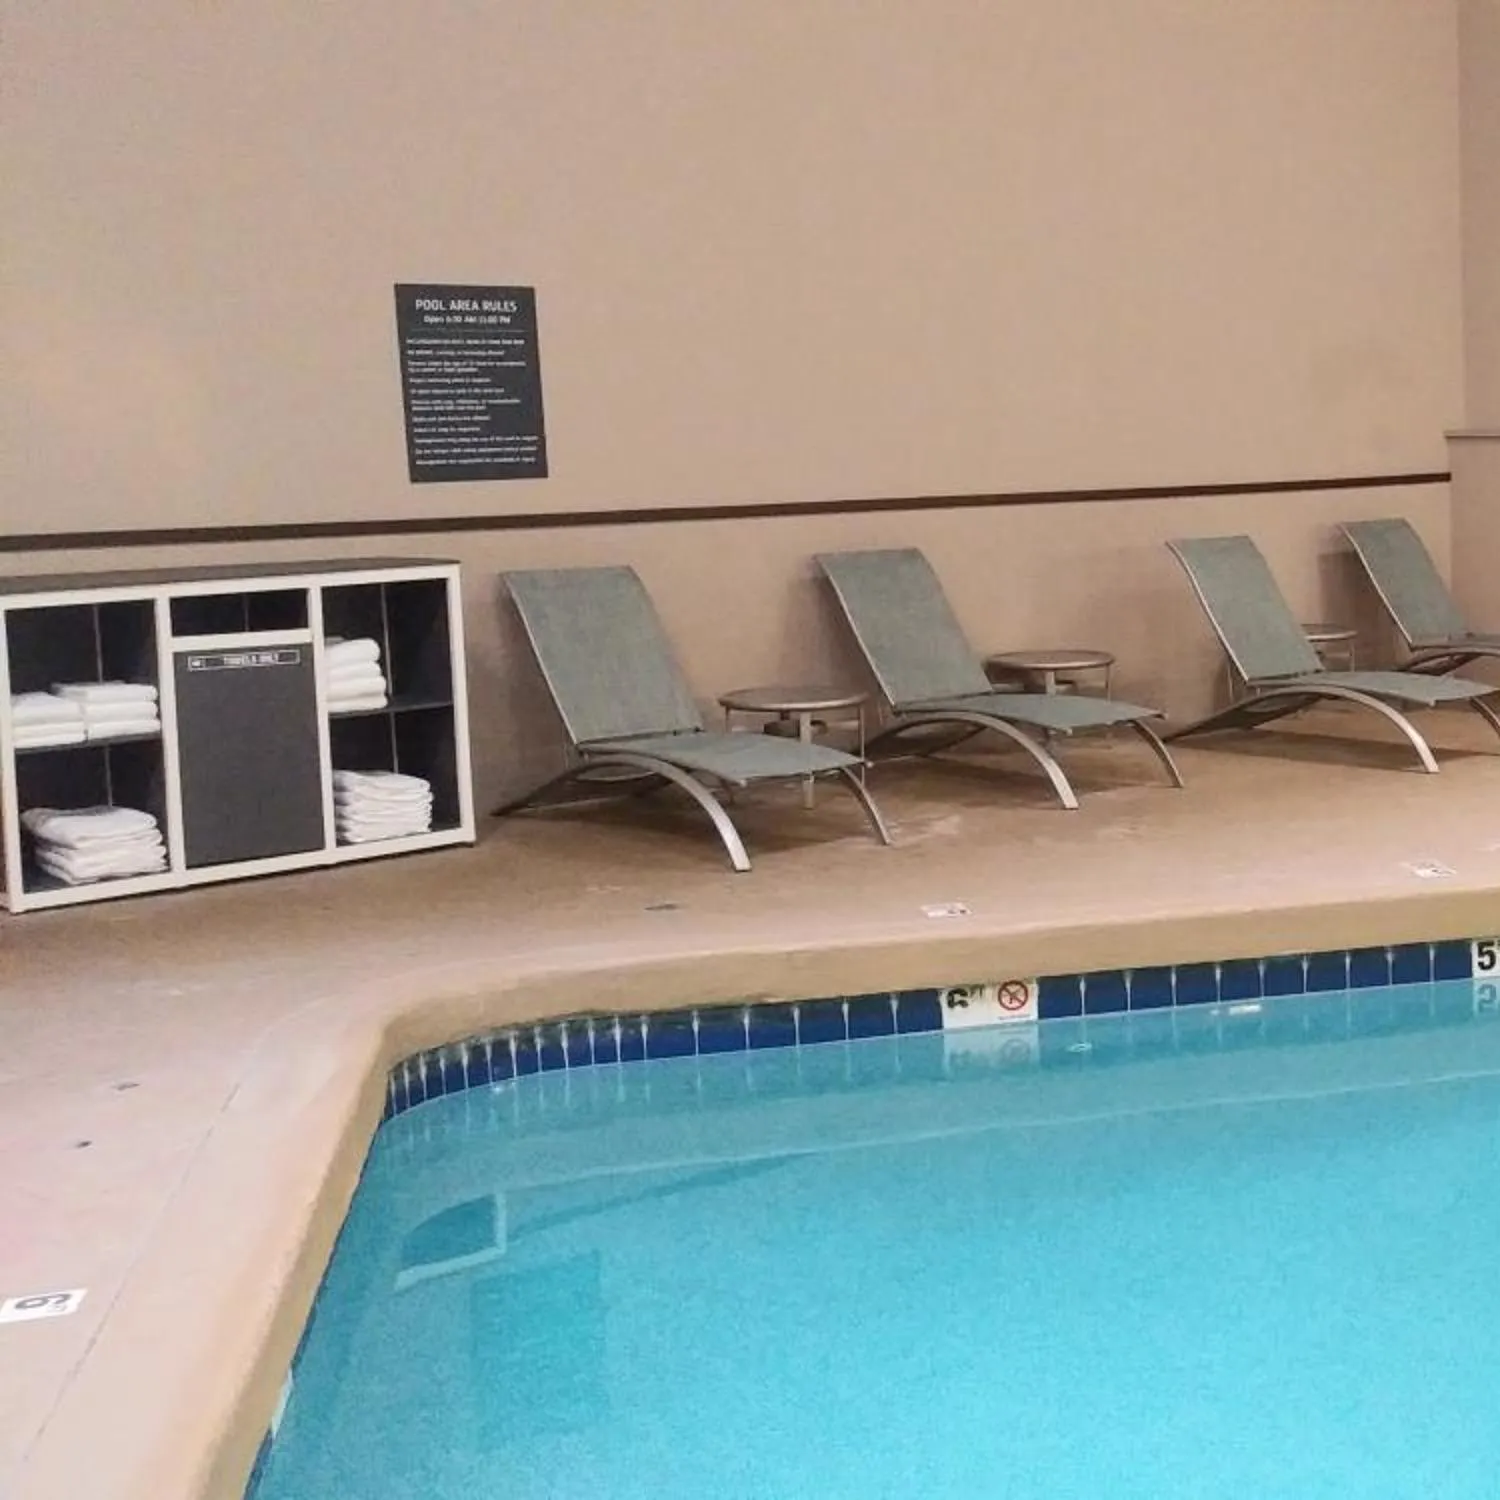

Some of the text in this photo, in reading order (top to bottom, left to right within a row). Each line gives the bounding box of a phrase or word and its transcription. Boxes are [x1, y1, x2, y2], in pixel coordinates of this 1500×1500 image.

[415, 299, 517, 313] POOL AREA RULES
[1477, 941, 1497, 970] 5
